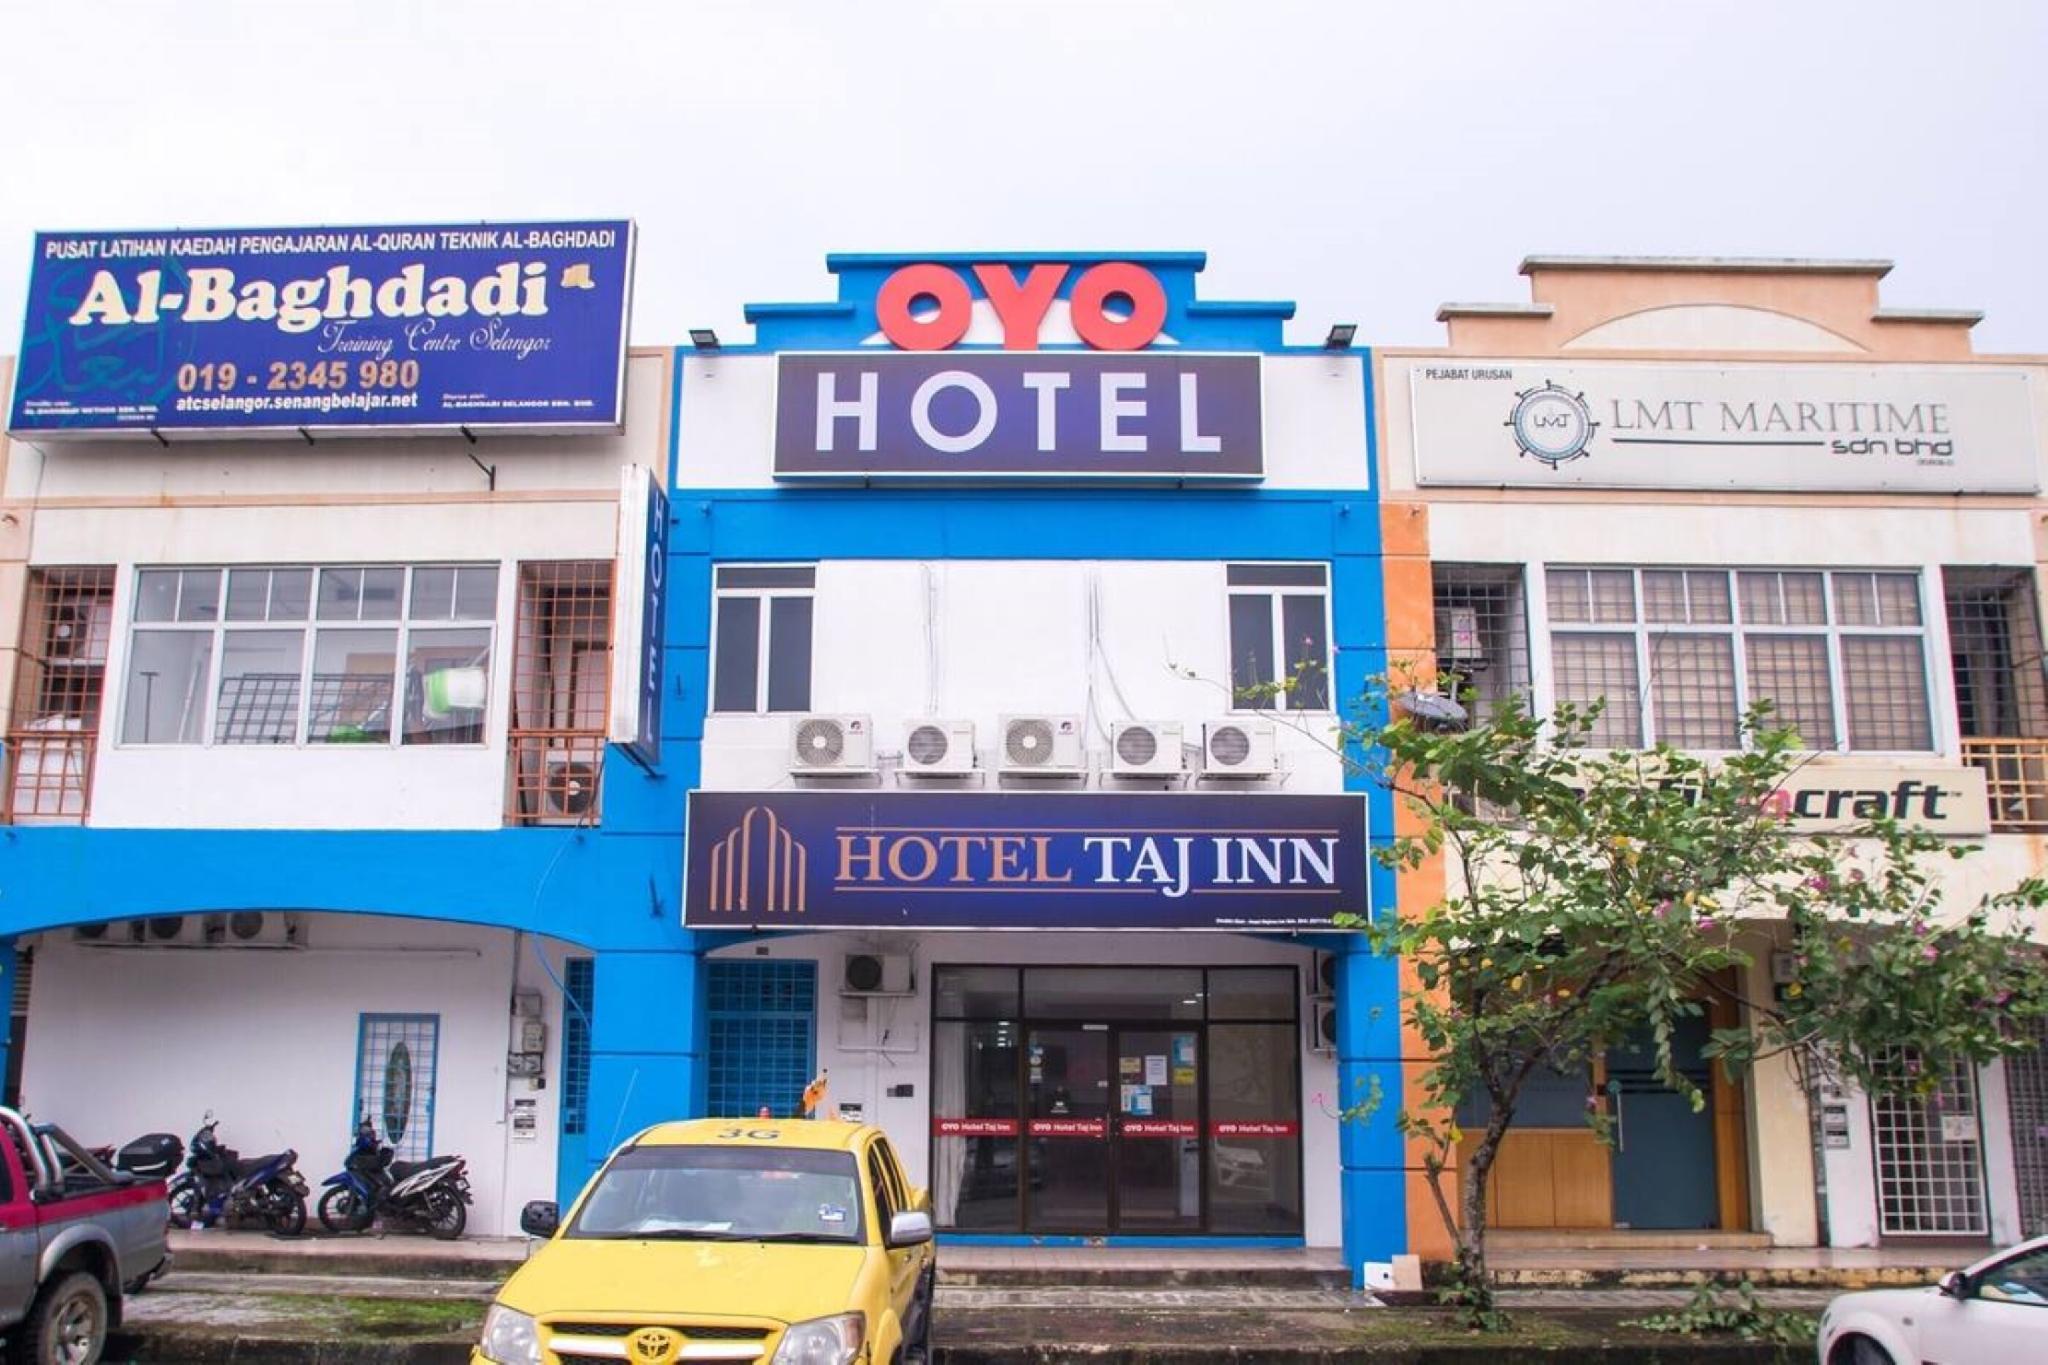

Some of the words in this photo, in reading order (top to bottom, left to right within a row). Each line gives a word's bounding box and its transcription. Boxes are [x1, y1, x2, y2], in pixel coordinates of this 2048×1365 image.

[46, 240, 97, 259] PUSAT
[100, 239, 166, 257] LATIHAN
[170, 237, 236, 256] KAEDAH
[240, 234, 347, 254] PENGAJARAN
[351, 233, 435, 251] AL-QURAN
[440, 231, 498, 249] TEKNIK
[502, 230, 615, 248] AL-BAGHDADI
[69, 262, 549, 333] Al-Baghdadi
[876, 262, 1167, 351] OYO
[317, 319, 393, 360] Training
[405, 317, 462, 352] Centre
[470, 319, 551, 360] Selangor
[177, 362, 237, 391] 019
[266, 360, 348, 390] 2345
[359, 359, 420, 389] 980
[1425, 369, 1469, 380] PEJABAT
[1471, 370, 1513, 380] URUSAN
[176, 392, 418, 412] atcselangor.senangbelajar.net
[816, 370, 1222, 453] HOTEL
[1611, 399, 1703, 432] LMT
[1720, 401, 1951, 434] MARITIME
[1832, 437, 1888, 455] sdn
[1895, 438, 1953, 456] bhd
[834, 835, 1071, 883] HOTEL
[1083, 835, 1194, 897] TAJ
[1211, 837, 1339, 884] INN
[717, 1128, 781, 1140] 3G
